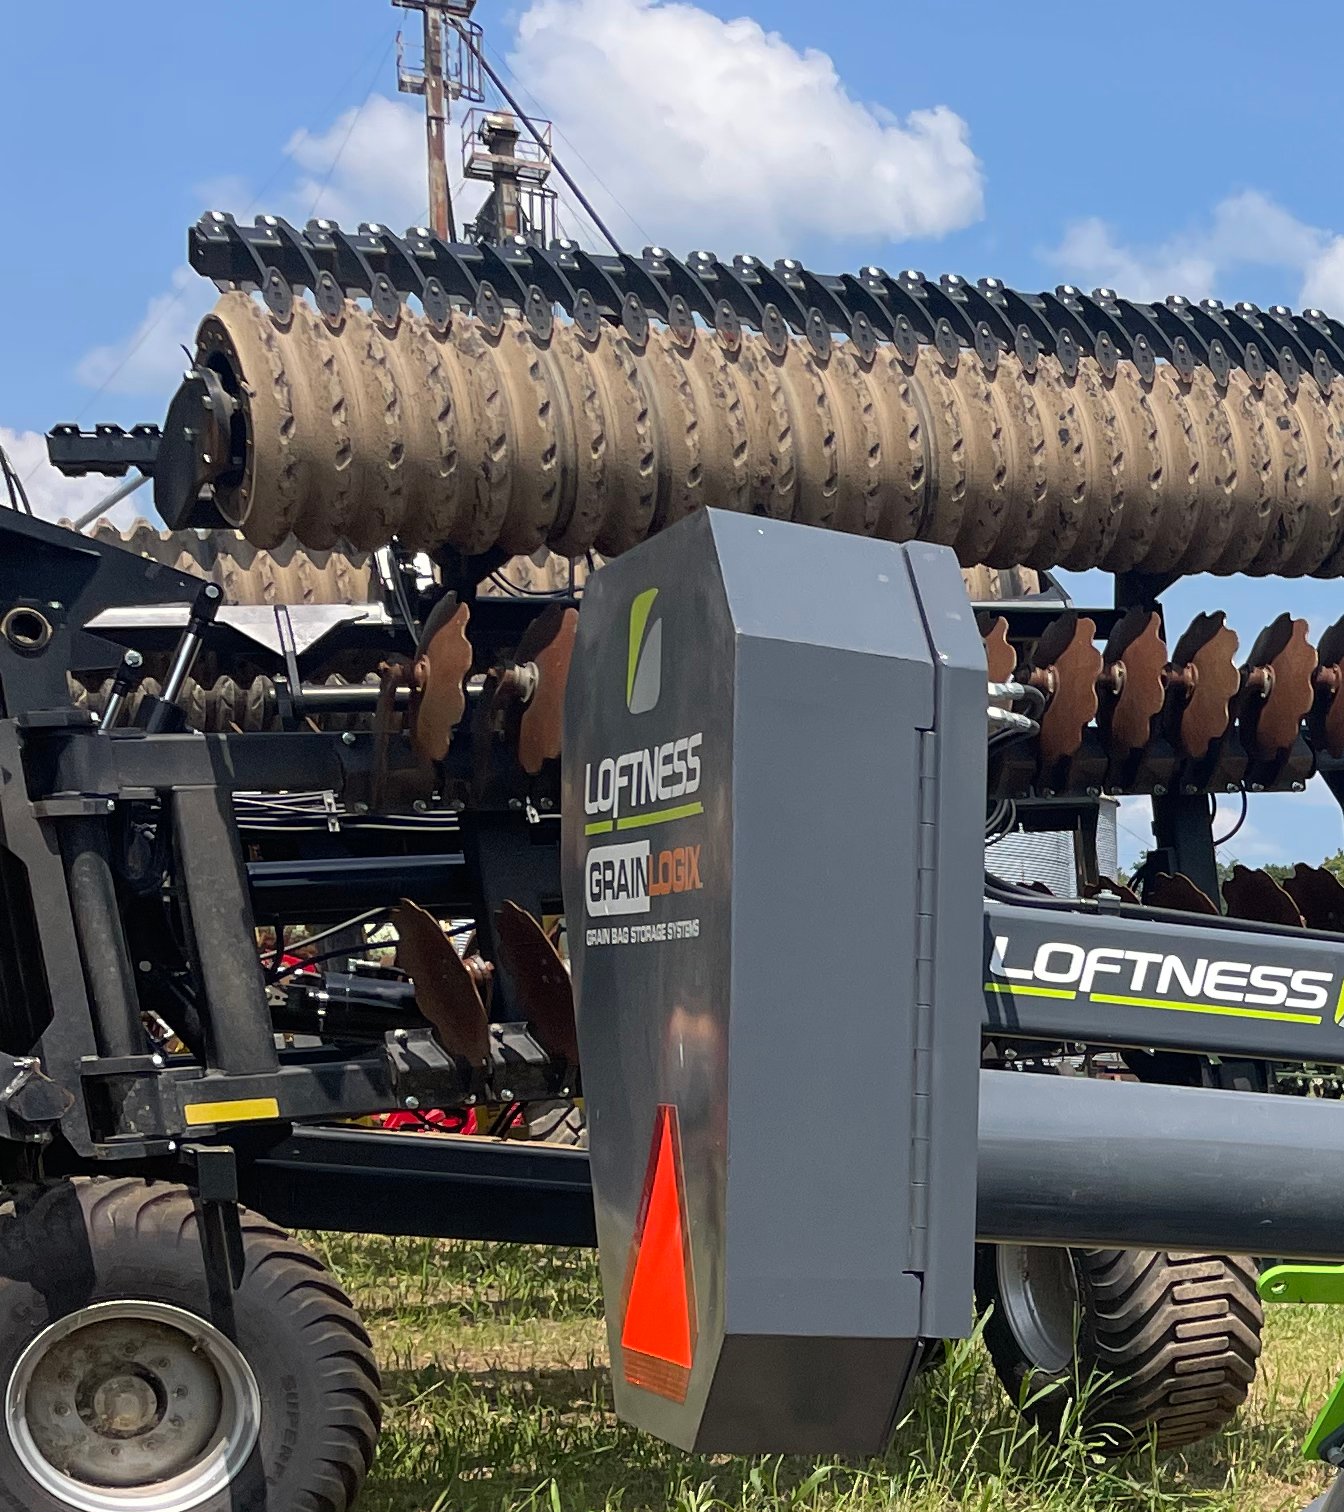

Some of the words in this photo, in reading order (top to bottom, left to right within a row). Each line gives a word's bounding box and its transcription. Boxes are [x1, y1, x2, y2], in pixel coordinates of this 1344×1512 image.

[584, 732, 702, 819] LOFTNESS
[586, 928, 610, 946] GRAIN
[611, 926, 629, 945] BAG
[630, 923, 667, 944] STORAGE
[667, 918, 700, 940] SYSTEMS
[989, 935, 1333, 1009] LOFTNESS
